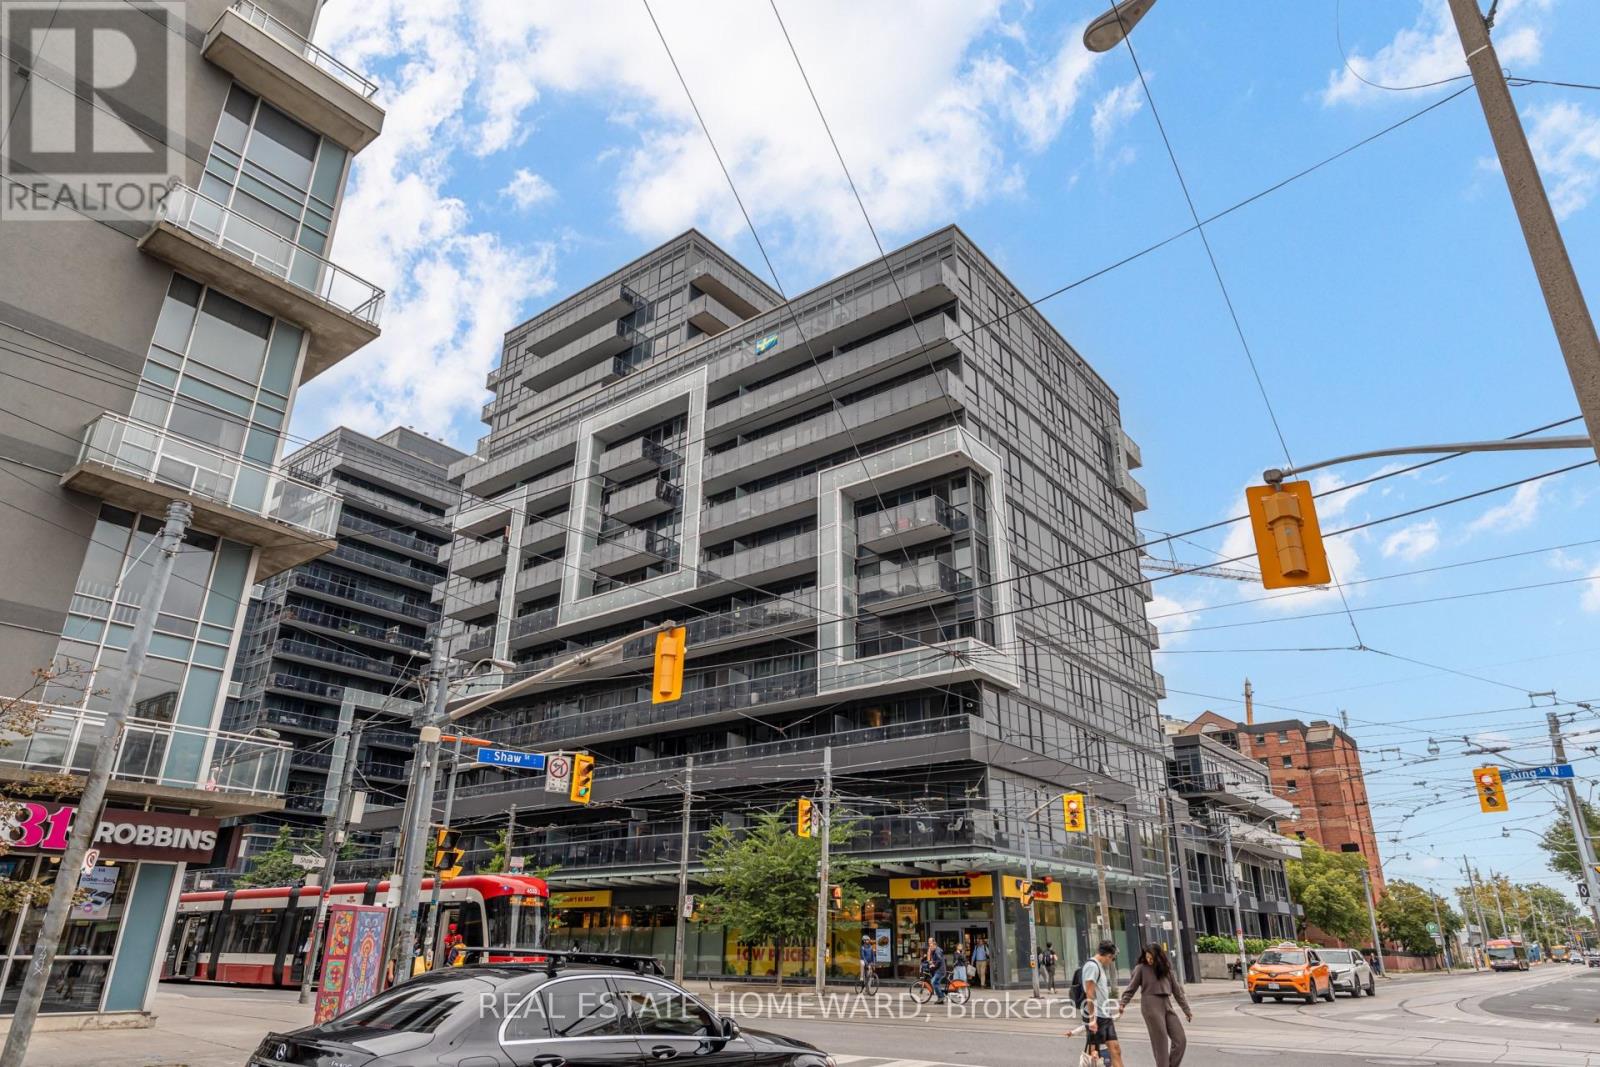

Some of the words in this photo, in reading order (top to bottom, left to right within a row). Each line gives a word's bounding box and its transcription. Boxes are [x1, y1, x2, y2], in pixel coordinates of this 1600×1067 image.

[494, 751, 522, 764] Shaw
[1511, 770, 1537, 780] King
[1549, 767, 1559, 776] W
[93, 821, 218, 851] ROBBINS
